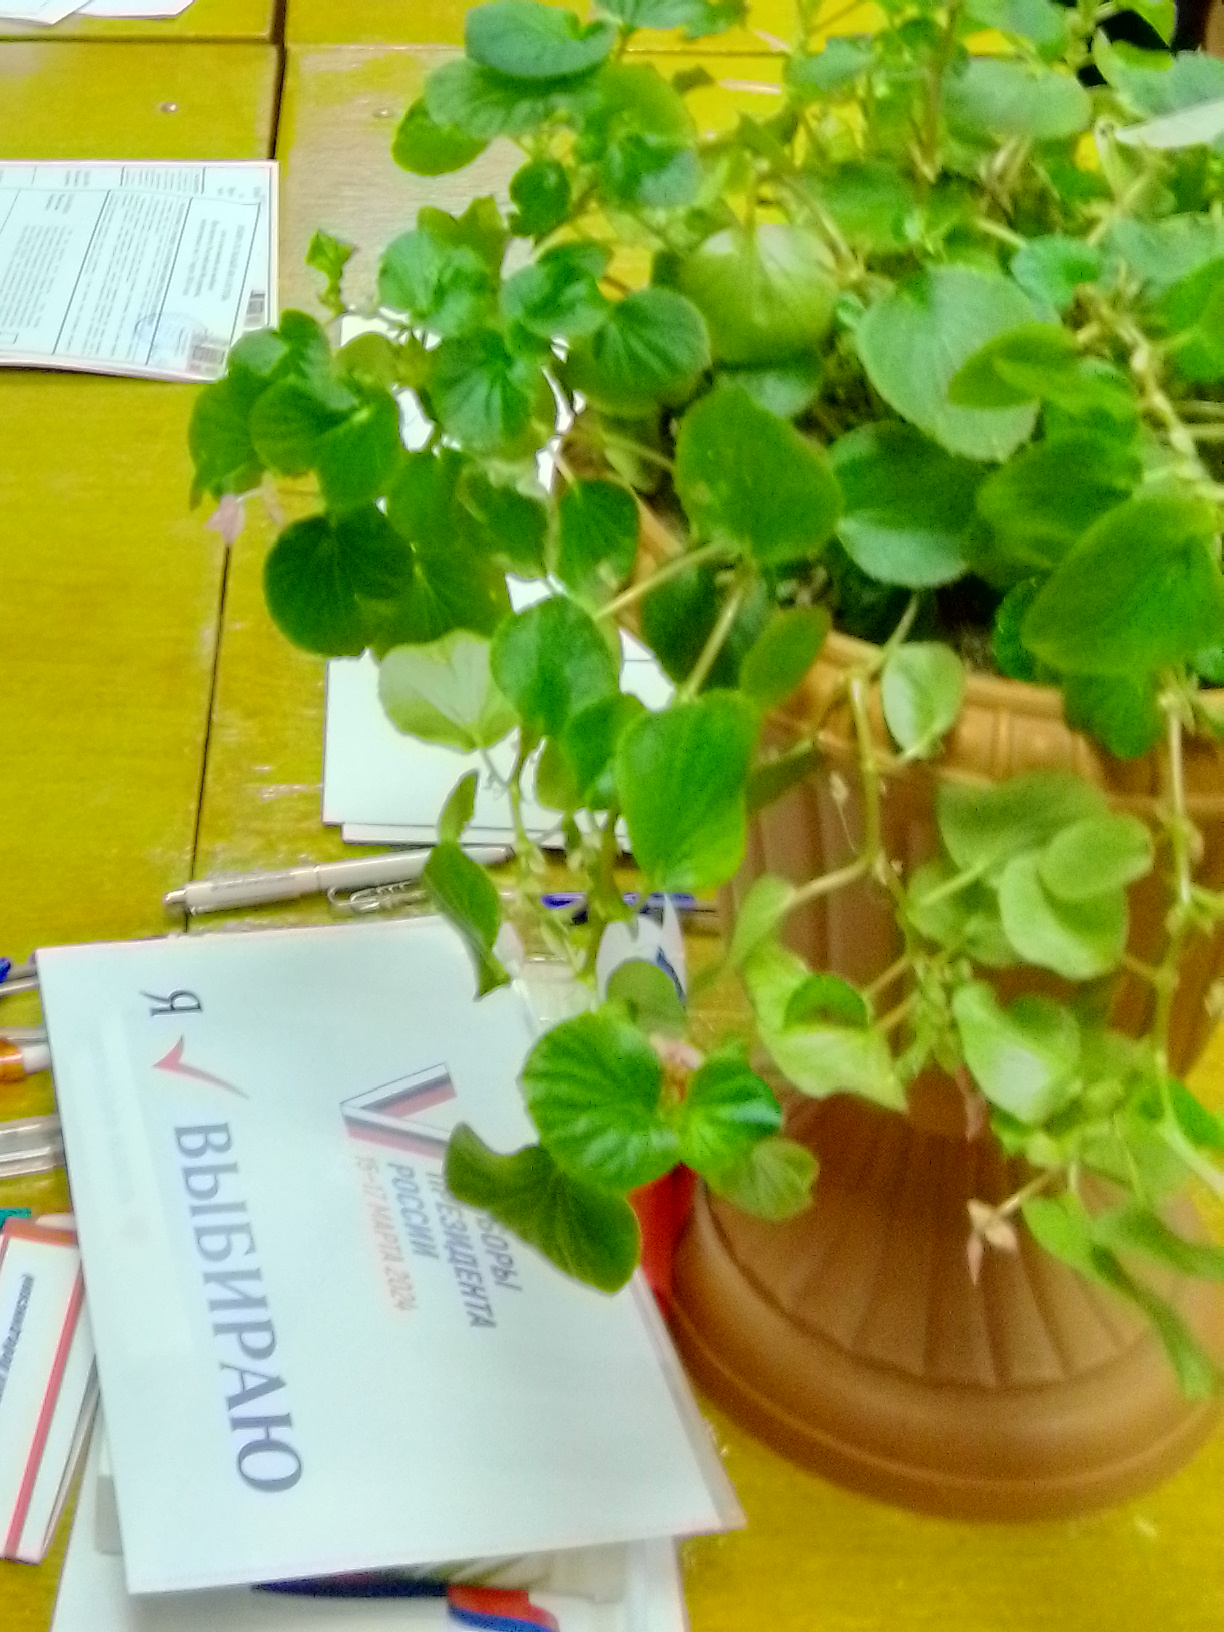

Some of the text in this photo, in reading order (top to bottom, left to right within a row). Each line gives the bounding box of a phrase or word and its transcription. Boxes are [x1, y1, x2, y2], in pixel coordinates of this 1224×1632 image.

[139, 987, 303, 1494] Я ВЫБИРАЮ
[387, 1162, 439, 1260] РОССИИ
